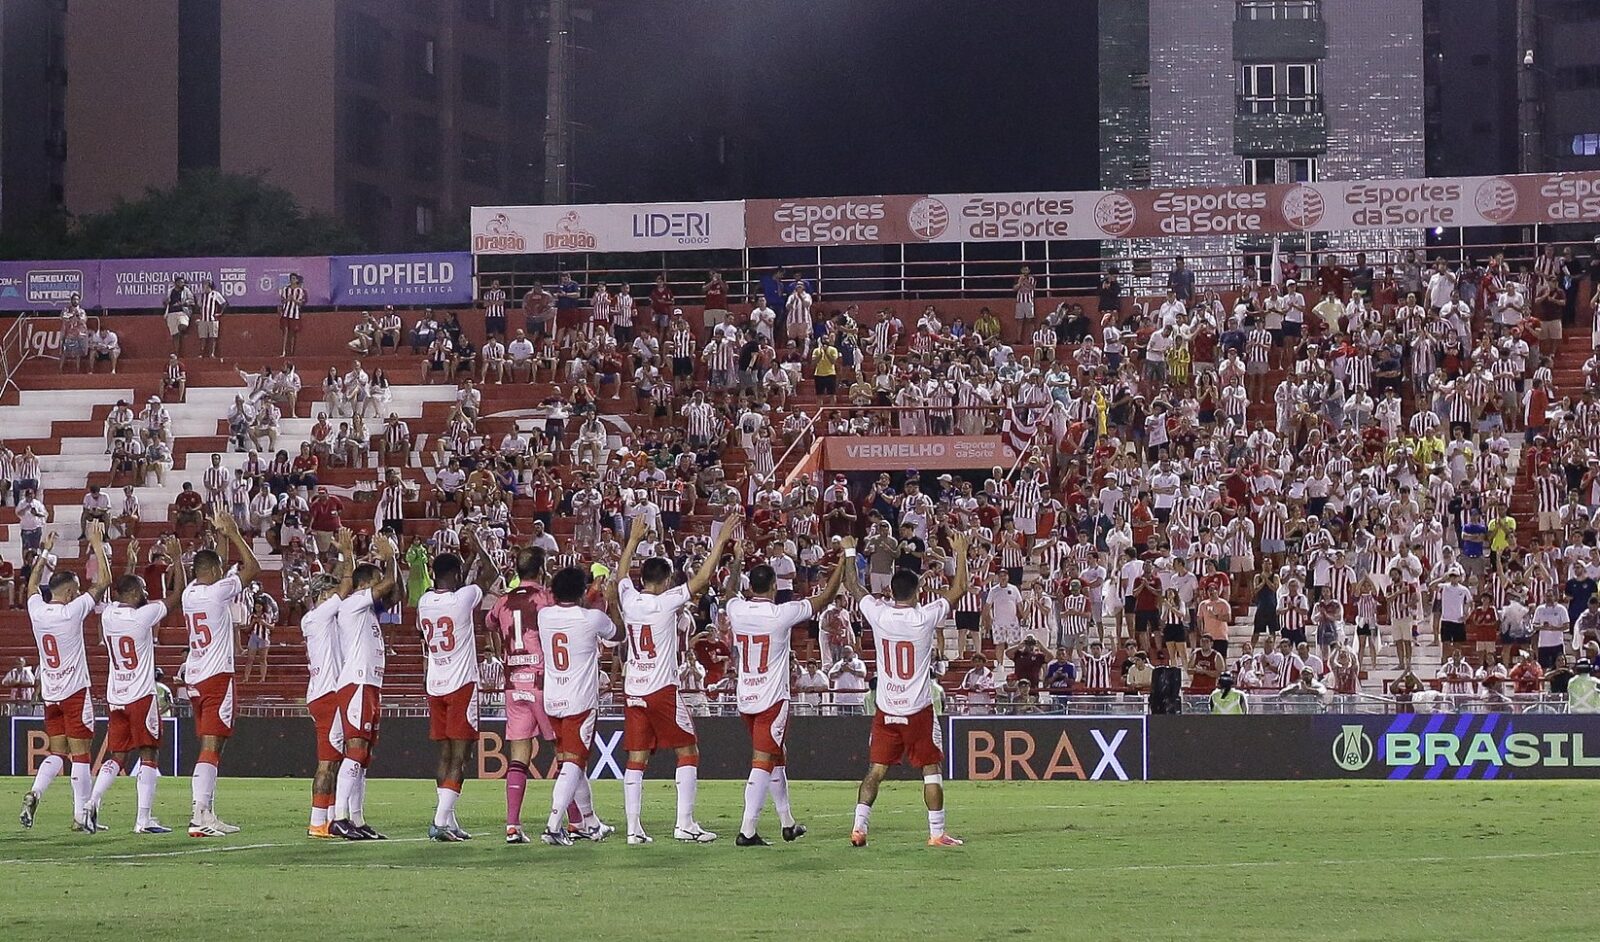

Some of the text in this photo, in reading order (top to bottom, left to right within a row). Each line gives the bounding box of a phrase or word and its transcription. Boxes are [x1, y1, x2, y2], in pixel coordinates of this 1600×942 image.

[1153, 190, 1267, 216] Esportes
[1345, 184, 1460, 208] Esportes
[774, 201, 885, 226] Esportes
[962, 197, 1074, 221] Esportes
[633, 213, 710, 237] LIDERI
[30, 275, 63, 283] MEXEU
[172, 271, 212, 282] CONTRA
[220, 273, 246, 281] LIGUE
[348, 262, 454, 286] TOPFIELD
[116, 285, 122, 295] A
[124, 284, 165, 295] MULHER
[220, 281, 246, 296] 190
[393, 286, 453, 294] SINTÉTICA
[846, 443, 945, 458] VERMELHO
[421, 616, 456, 653] 23
[513, 610, 524, 649] 1
[627, 624, 657, 659] 14
[42, 634, 60, 668] 9
[107, 635, 139, 670] 19
[551, 632, 570, 671] 6
[736, 635, 770, 673] 17
[882, 638, 915, 680] 10
[478, 731, 625, 779] BX
[968, 729, 1130, 780] BRAX
[1386, 733, 1600, 767] BRASIL
